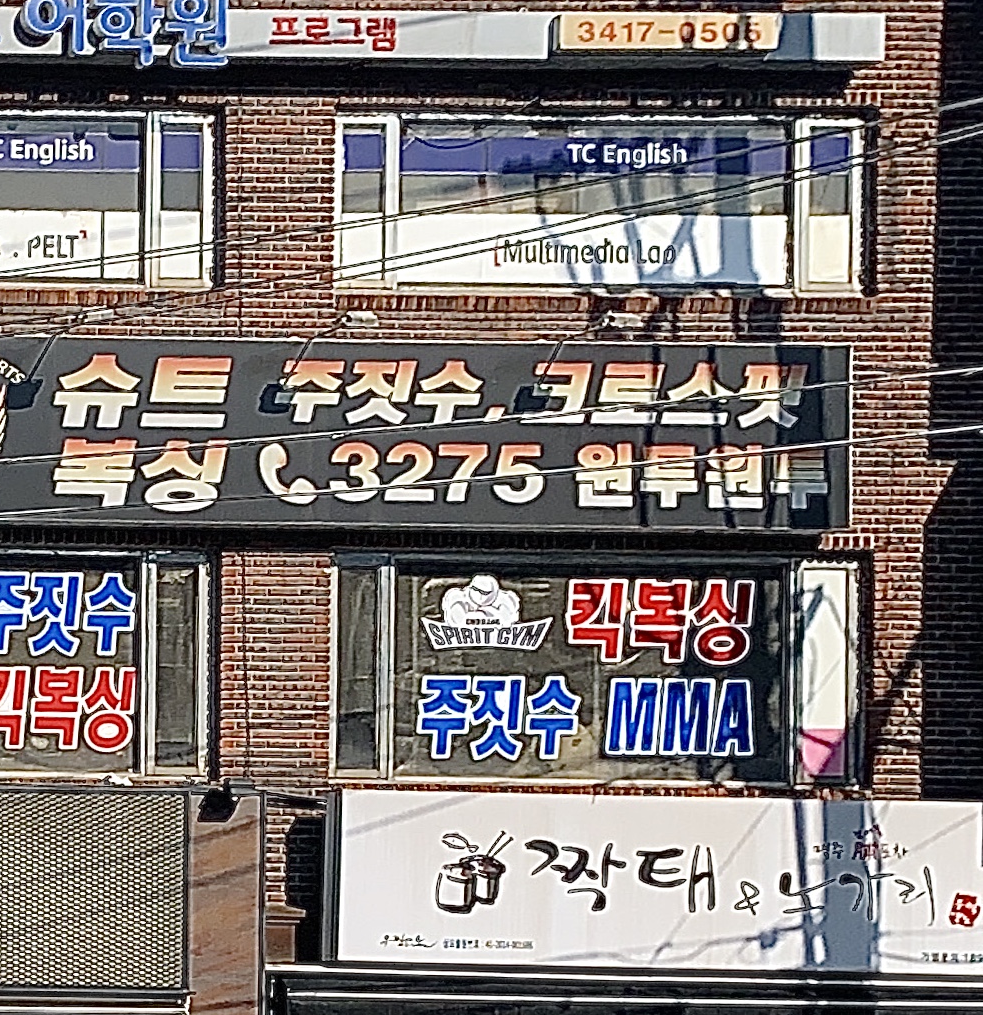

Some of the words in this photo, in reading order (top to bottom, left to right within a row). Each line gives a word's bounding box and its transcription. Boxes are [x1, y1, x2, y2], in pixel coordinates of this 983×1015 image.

[269, 16, 397, 52] 프로그램
[10, 138, 94, 164] English
[566, 143, 596, 164] TC
[602, 143, 688, 169] English
[53, 353, 232, 428] 슈트
[53, 437, 230, 512] 복싱
[329, 441, 546, 504] 3275
[428, 622, 494, 646] SPIRIT
[497, 622, 548, 647] GYM
[565, 578, 755, 666] 킥복싱
[417, 674, 582, 762] 주짓수
[604, 678, 754, 758] MMA
[525, 839, 715, 913] 짝태
